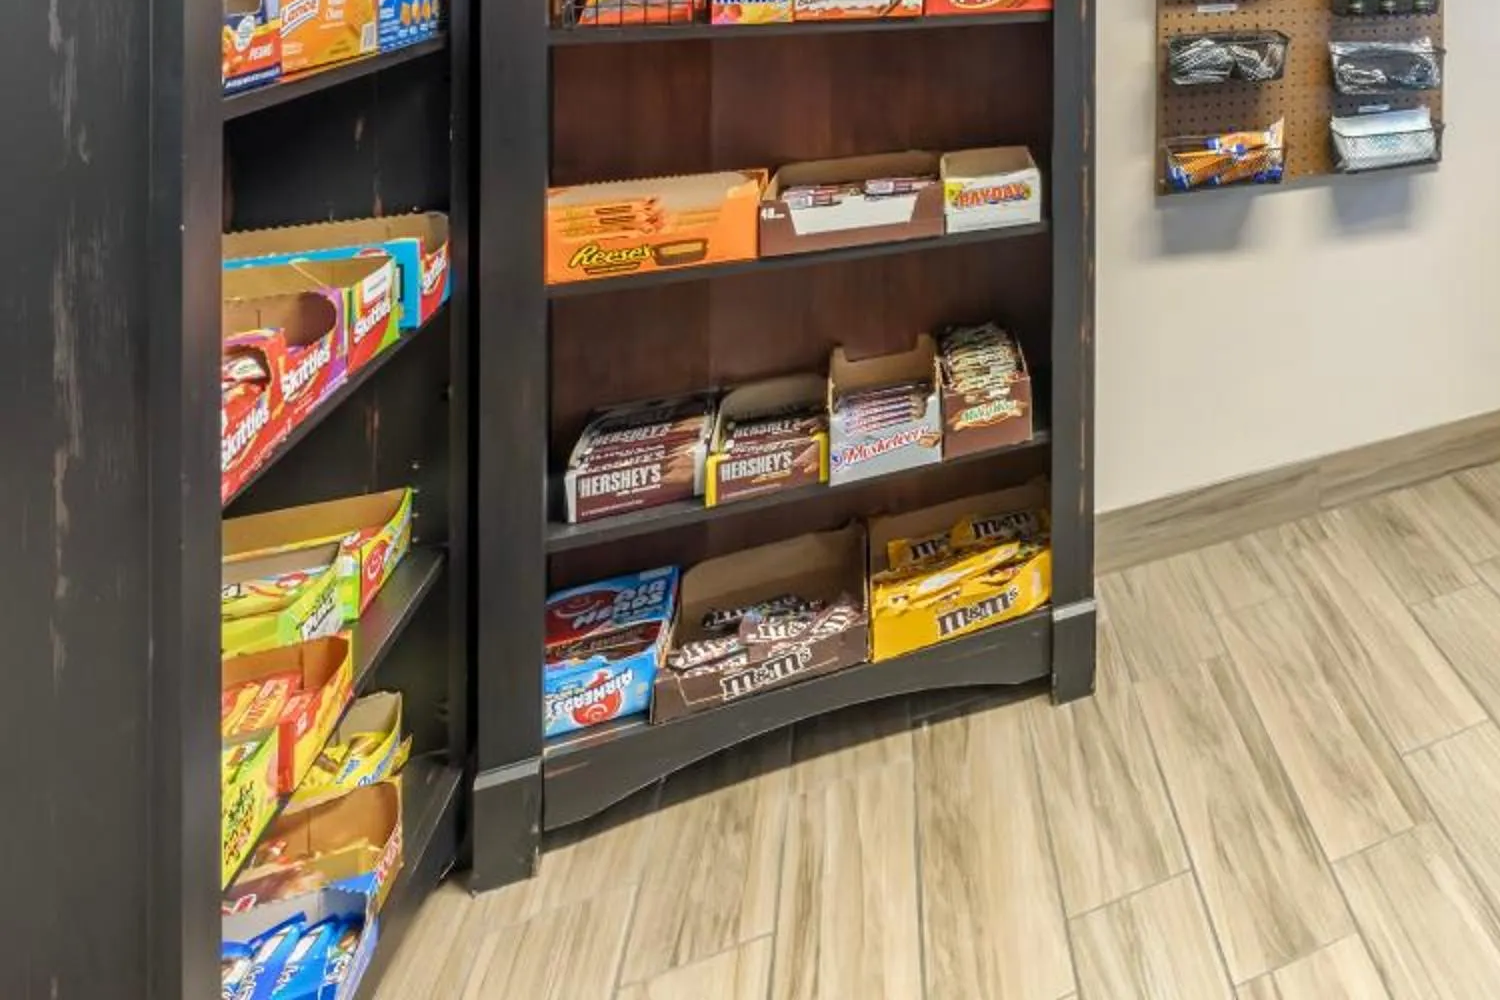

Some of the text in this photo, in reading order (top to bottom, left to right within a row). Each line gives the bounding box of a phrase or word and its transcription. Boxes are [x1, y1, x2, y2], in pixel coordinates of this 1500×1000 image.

[569, 242, 655, 269] Reese's
[353, 299, 391, 343] Skittles
[281, 341, 330, 401] Skittles
[580, 464, 661, 498] HERSHEY'S
[720, 451, 792, 483] HERSHEY'S
[937, 586, 1019, 637] m&m's
[721, 642, 812, 700] m&m's
